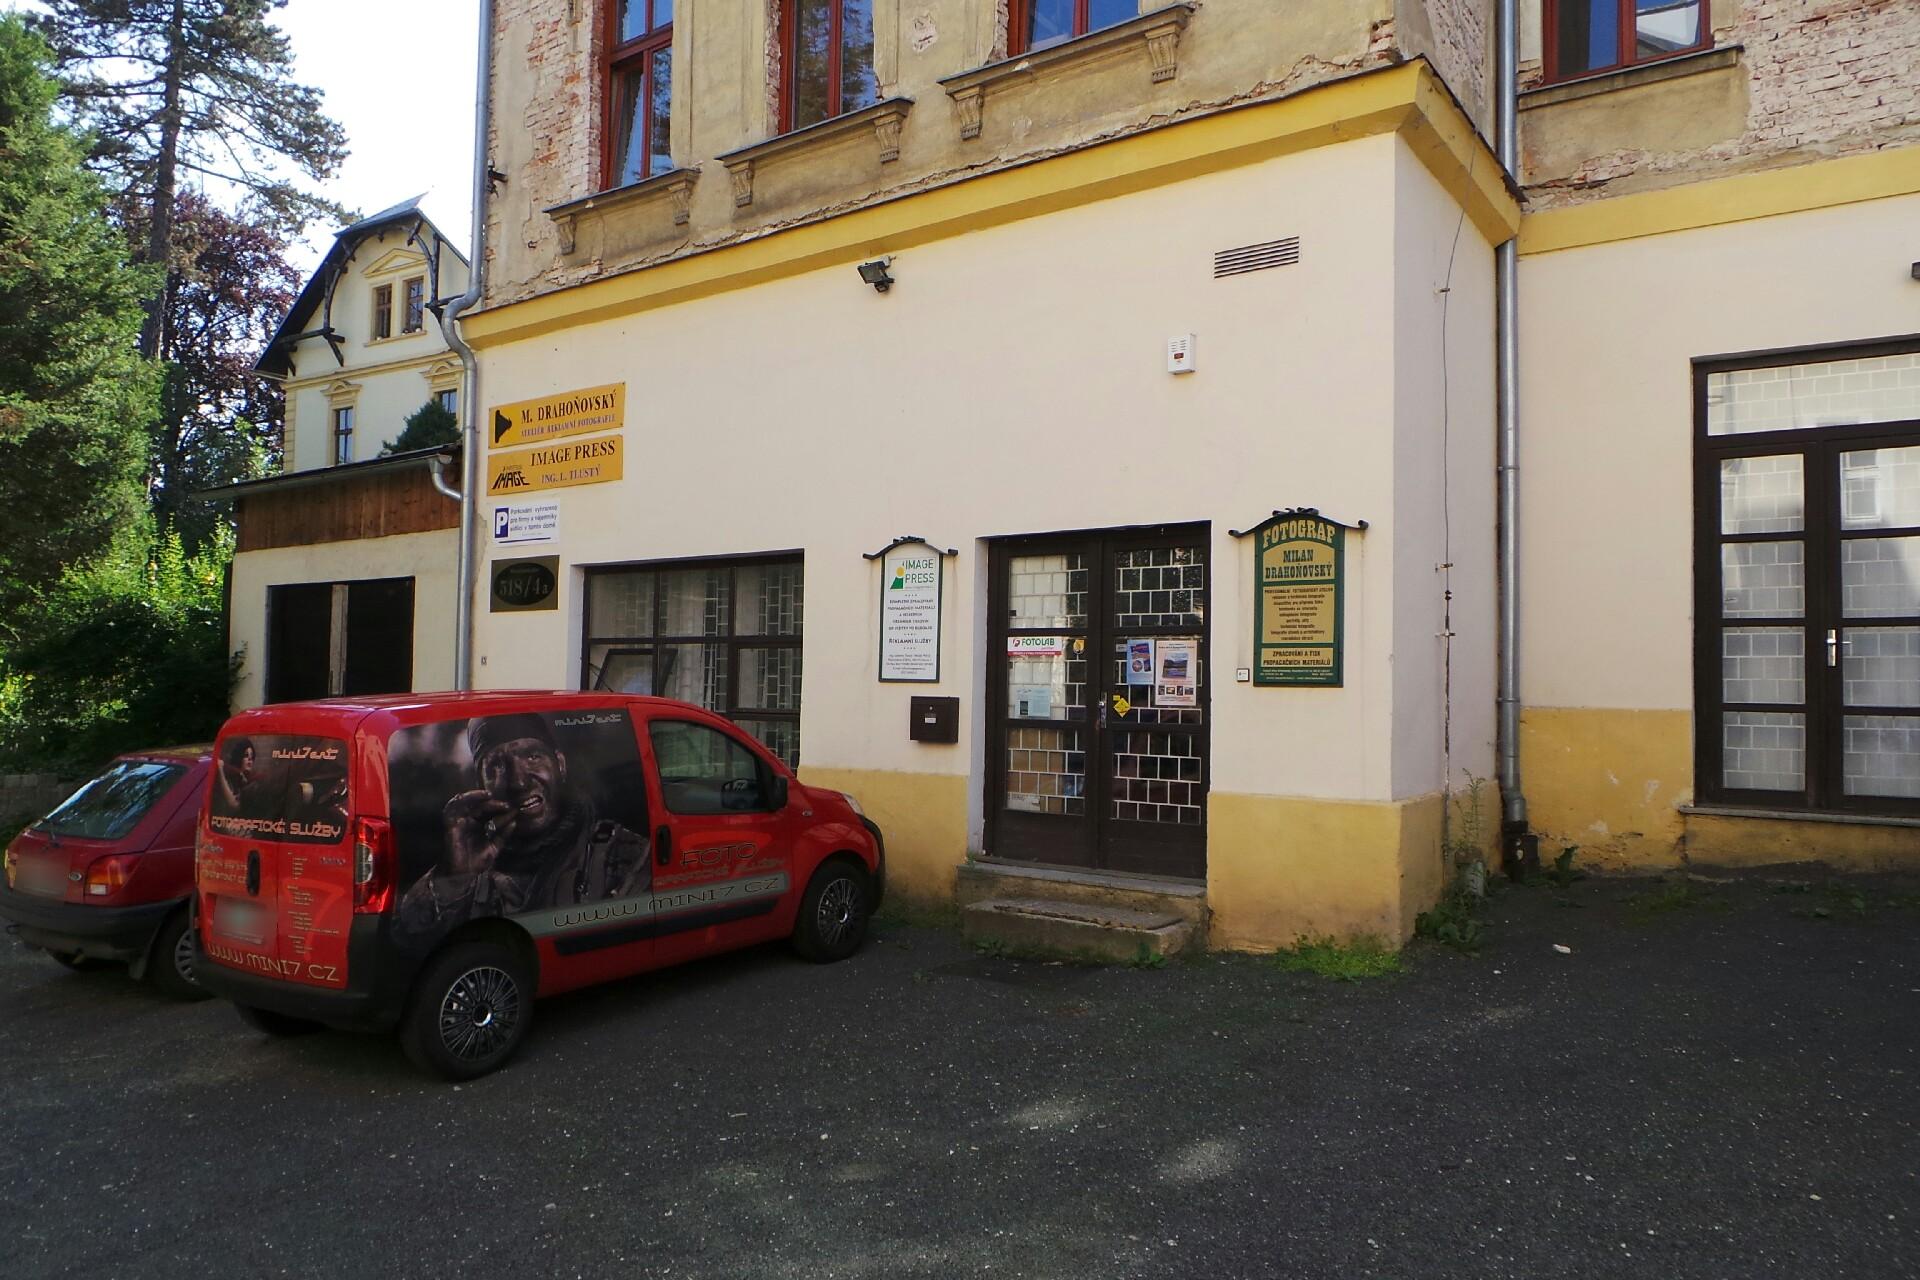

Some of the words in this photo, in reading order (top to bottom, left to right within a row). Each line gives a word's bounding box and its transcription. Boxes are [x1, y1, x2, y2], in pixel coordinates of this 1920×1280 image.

[521, 409, 533, 424] M.
[538, 389, 616, 421] DRAHOŇOVSKÝ
[530, 447, 571, 466] IMAGE
[574, 440, 615, 460] PRESS
[541, 474, 558, 484] ING.
[495, 511, 508, 534] P
[1263, 519, 1335, 548] FOTOGRAF
[905, 559, 934, 570] IMAGE
[1283, 549, 1314, 563] MILAN
[905, 573, 935, 583] PRESS
[1265, 561, 1332, 579] DRAHOŇOVSKÝ
[1022, 638, 1055, 647] FOTOLAB
[289, 821, 341, 838] SLUŽBY
[681, 843, 758, 867] FOTO
